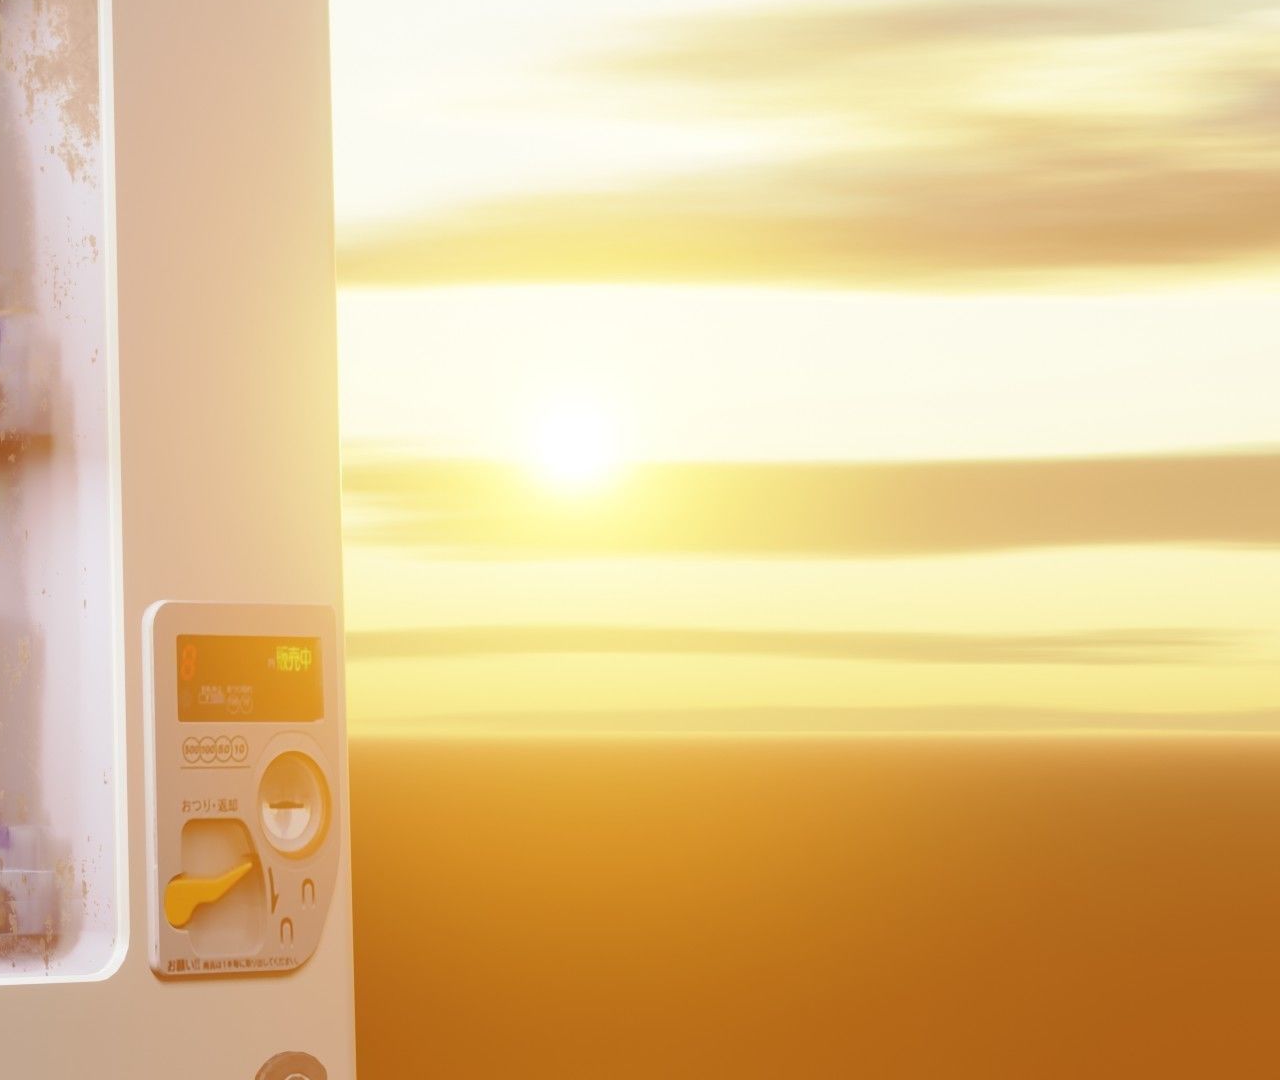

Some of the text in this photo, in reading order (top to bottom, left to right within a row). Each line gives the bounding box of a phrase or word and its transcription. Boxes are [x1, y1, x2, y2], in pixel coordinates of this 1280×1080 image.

[276, 646, 312, 671] 販売中
[234, 743, 246, 754] 10
[181, 799, 239, 813] おつり・返却
